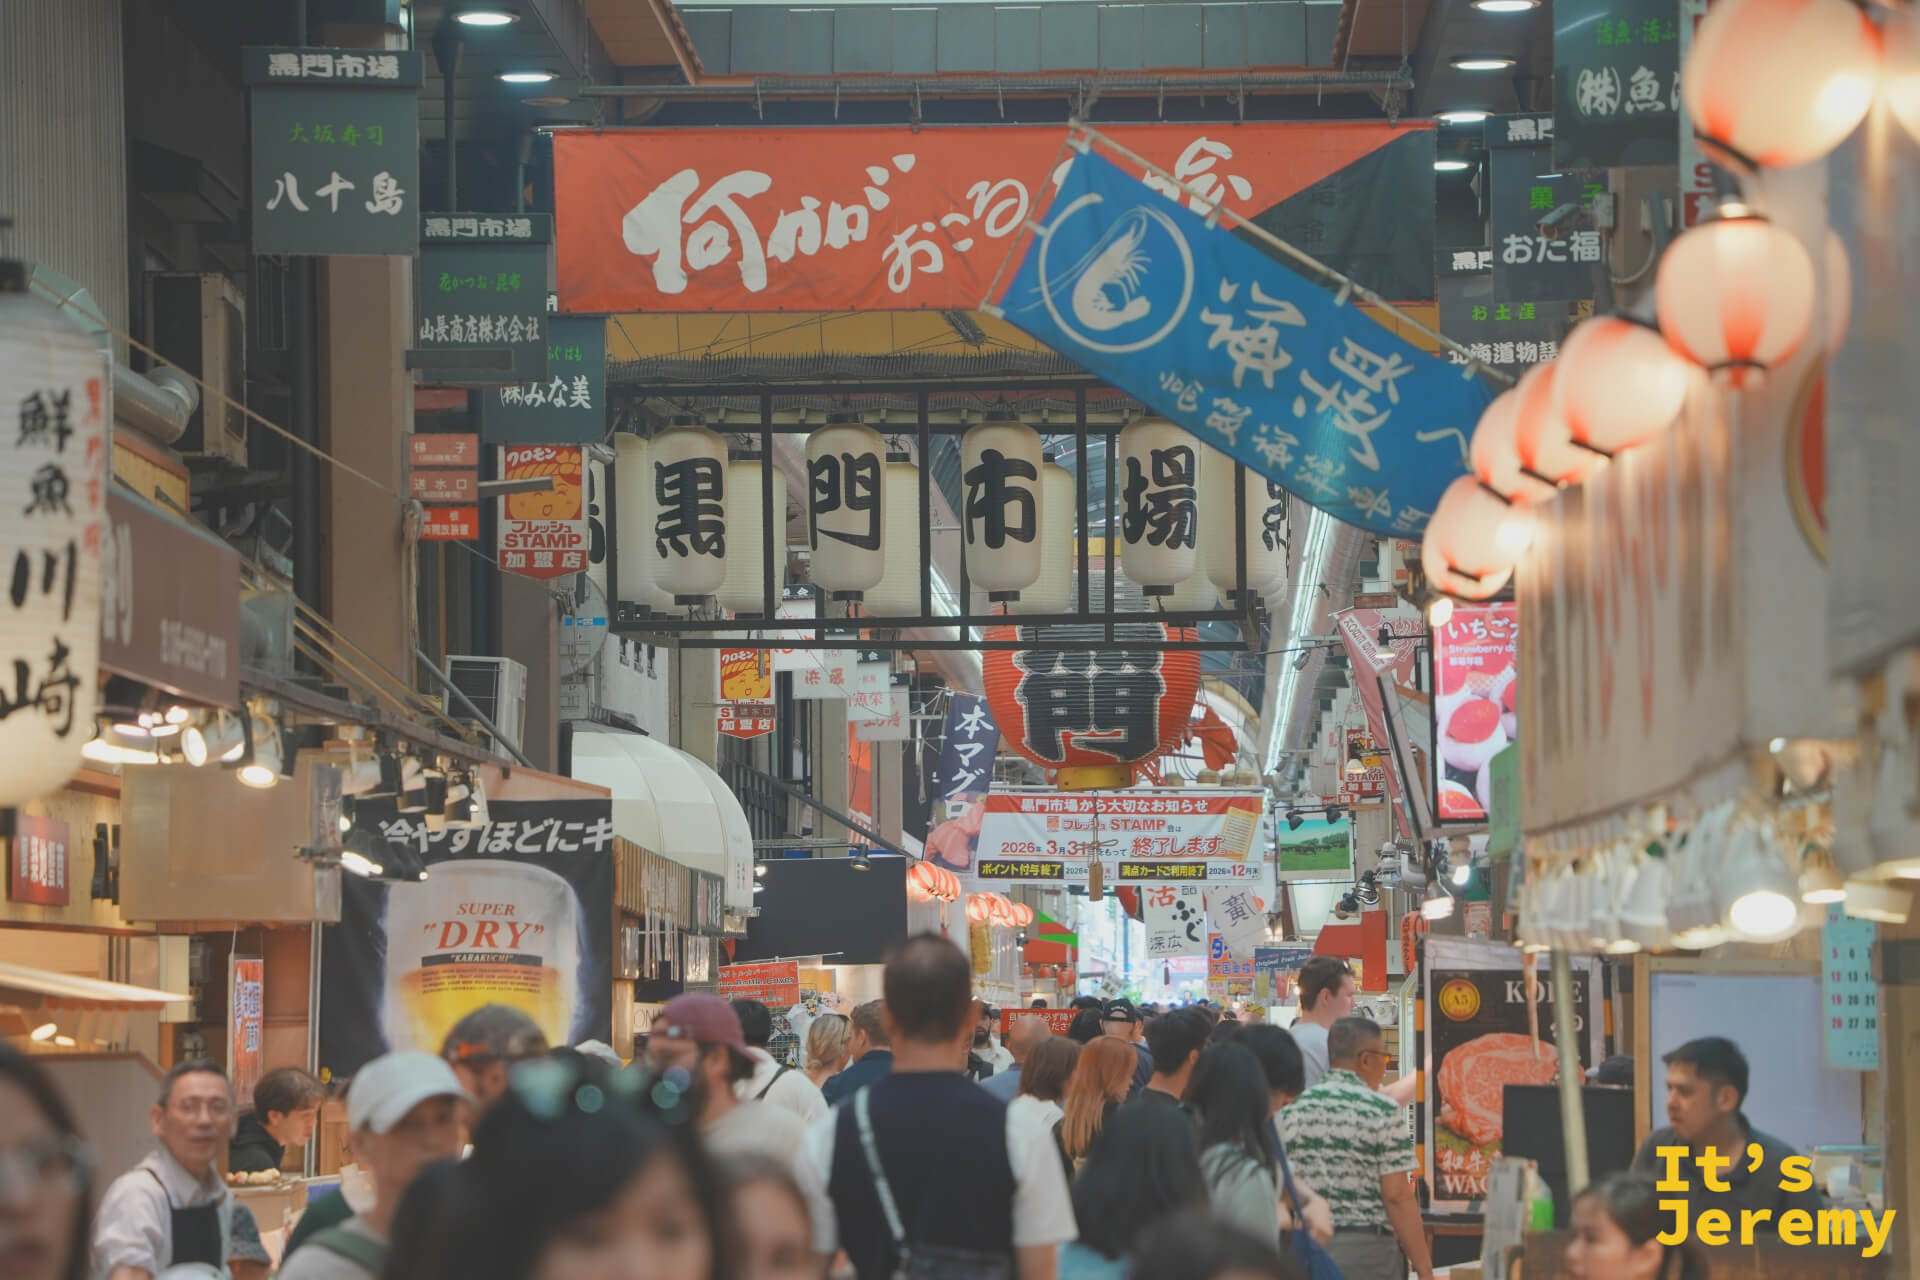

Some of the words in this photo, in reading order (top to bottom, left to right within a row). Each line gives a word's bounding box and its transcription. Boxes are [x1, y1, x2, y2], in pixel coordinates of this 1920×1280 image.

[268, 53, 400, 79] 黒門市場
[266, 171, 405, 215] 八十島
[425, 218, 532, 238] 黒門市場
[1502, 233, 1601, 264] おた福
[1472, 302, 1536, 321] お土産
[420, 314, 540, 343] 山長商店株式会社
[507, 449, 557, 466] クロモン
[511, 520, 573, 534] フレッシュ
[504, 533, 582, 549] STAMP
[505, 552, 582, 569] 加盟店
[721, 652, 755, 664] クロモン
[721, 719, 771, 731] 加盟店
[944, 705, 994, 820] 本マグロ
[1021, 798, 1208, 814] 黒門市場から大切なお知らせ
[1111, 818, 1166, 831] STAMP
[981, 863, 1062, 877] ポイント付与終了
[456, 903, 515, 916] SUPER
[1505, 980, 1583, 1003] KOE
